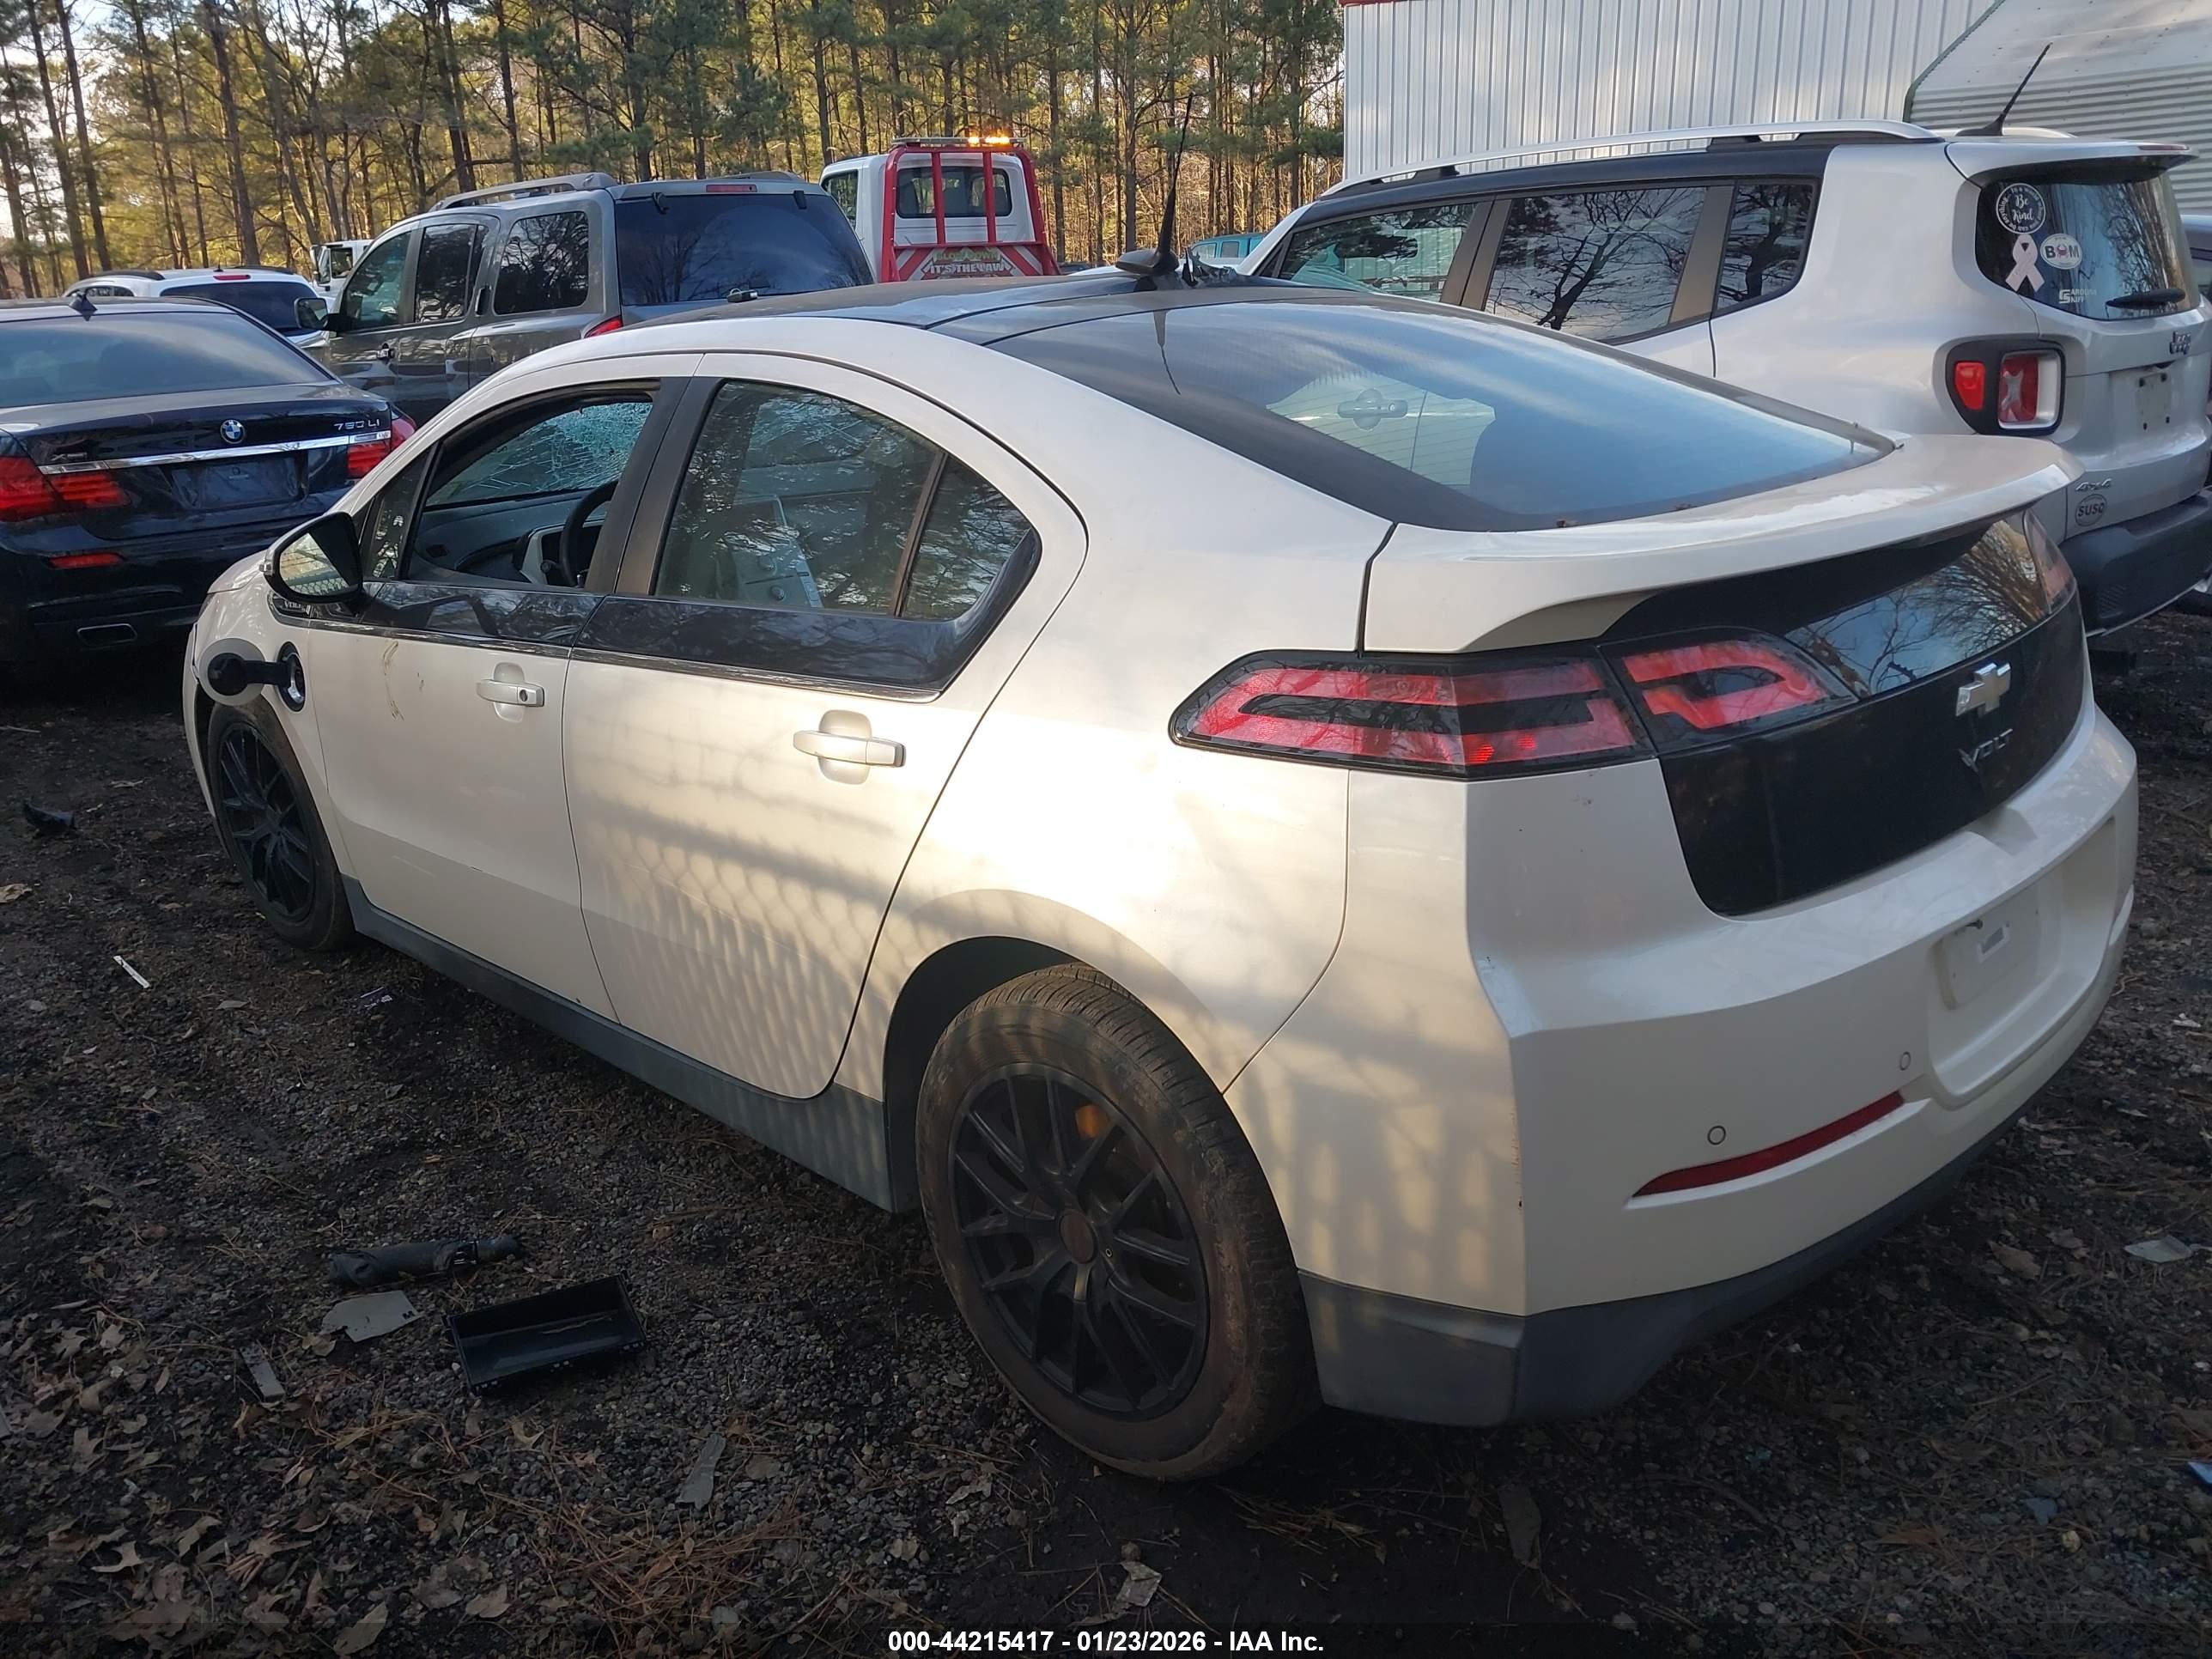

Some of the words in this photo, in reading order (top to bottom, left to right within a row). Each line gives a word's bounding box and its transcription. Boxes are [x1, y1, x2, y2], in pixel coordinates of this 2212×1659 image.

[2015, 194, 2029, 209] Be
[2012, 207, 2034, 223] Kind
[957, 263, 977, 273] THE
[1958, 728, 2013, 772] VOLT
